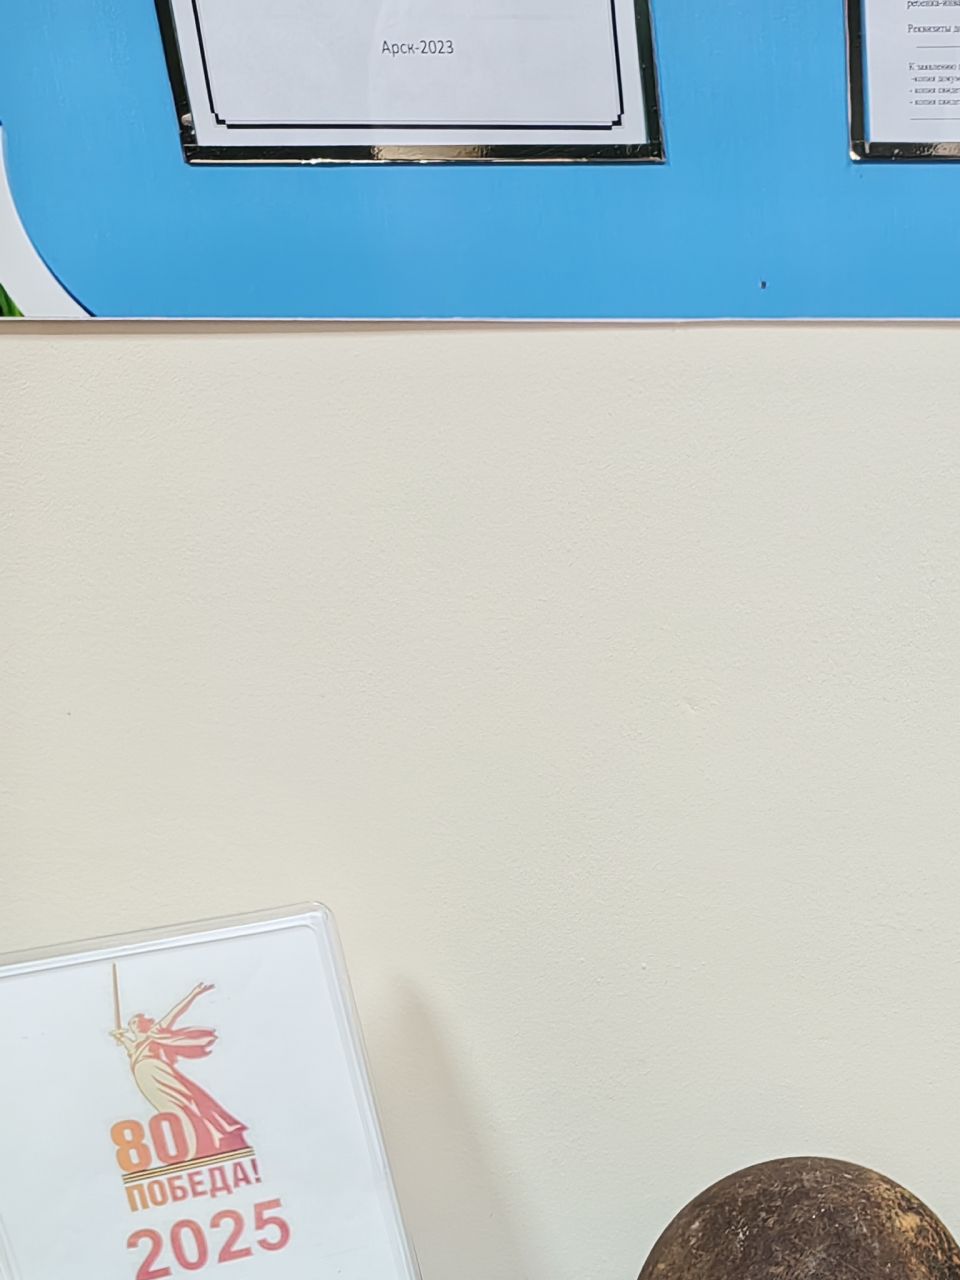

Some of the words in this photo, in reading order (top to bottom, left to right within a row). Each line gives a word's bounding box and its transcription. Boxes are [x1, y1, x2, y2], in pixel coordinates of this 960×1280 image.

[382, 40, 455, 57] Арск-2023
[110, 1112, 191, 1174] 80
[124, 1158, 262, 1212] ПОБЕДА!
